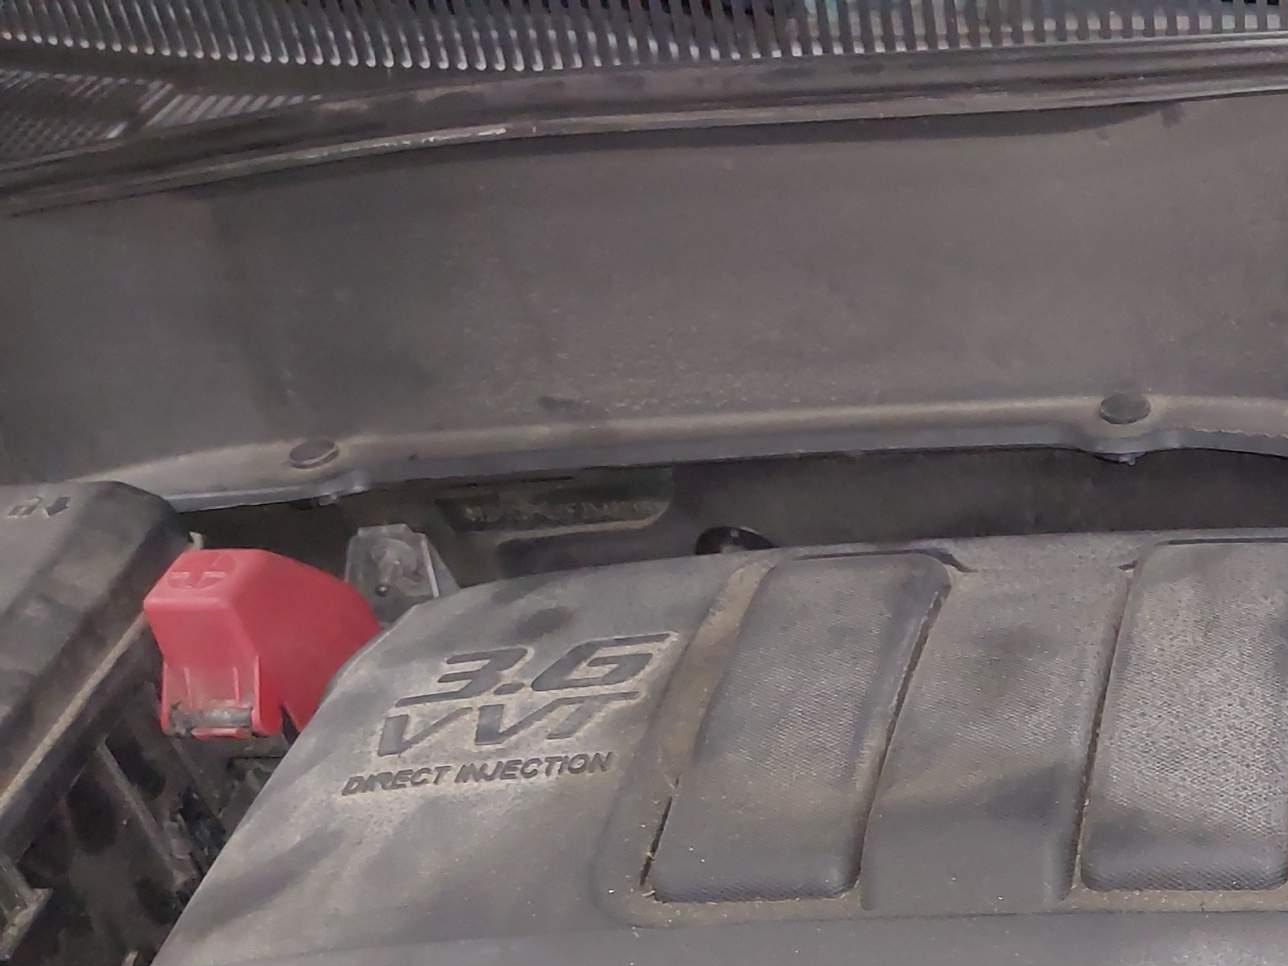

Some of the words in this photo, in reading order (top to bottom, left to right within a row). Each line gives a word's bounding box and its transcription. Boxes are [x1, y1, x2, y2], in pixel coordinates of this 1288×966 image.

[395, 632, 678, 707] 3.6
[377, 691, 641, 757] VVT
[342, 766, 452, 796] DIRECT
[454, 752, 613, 785] INJECTION
